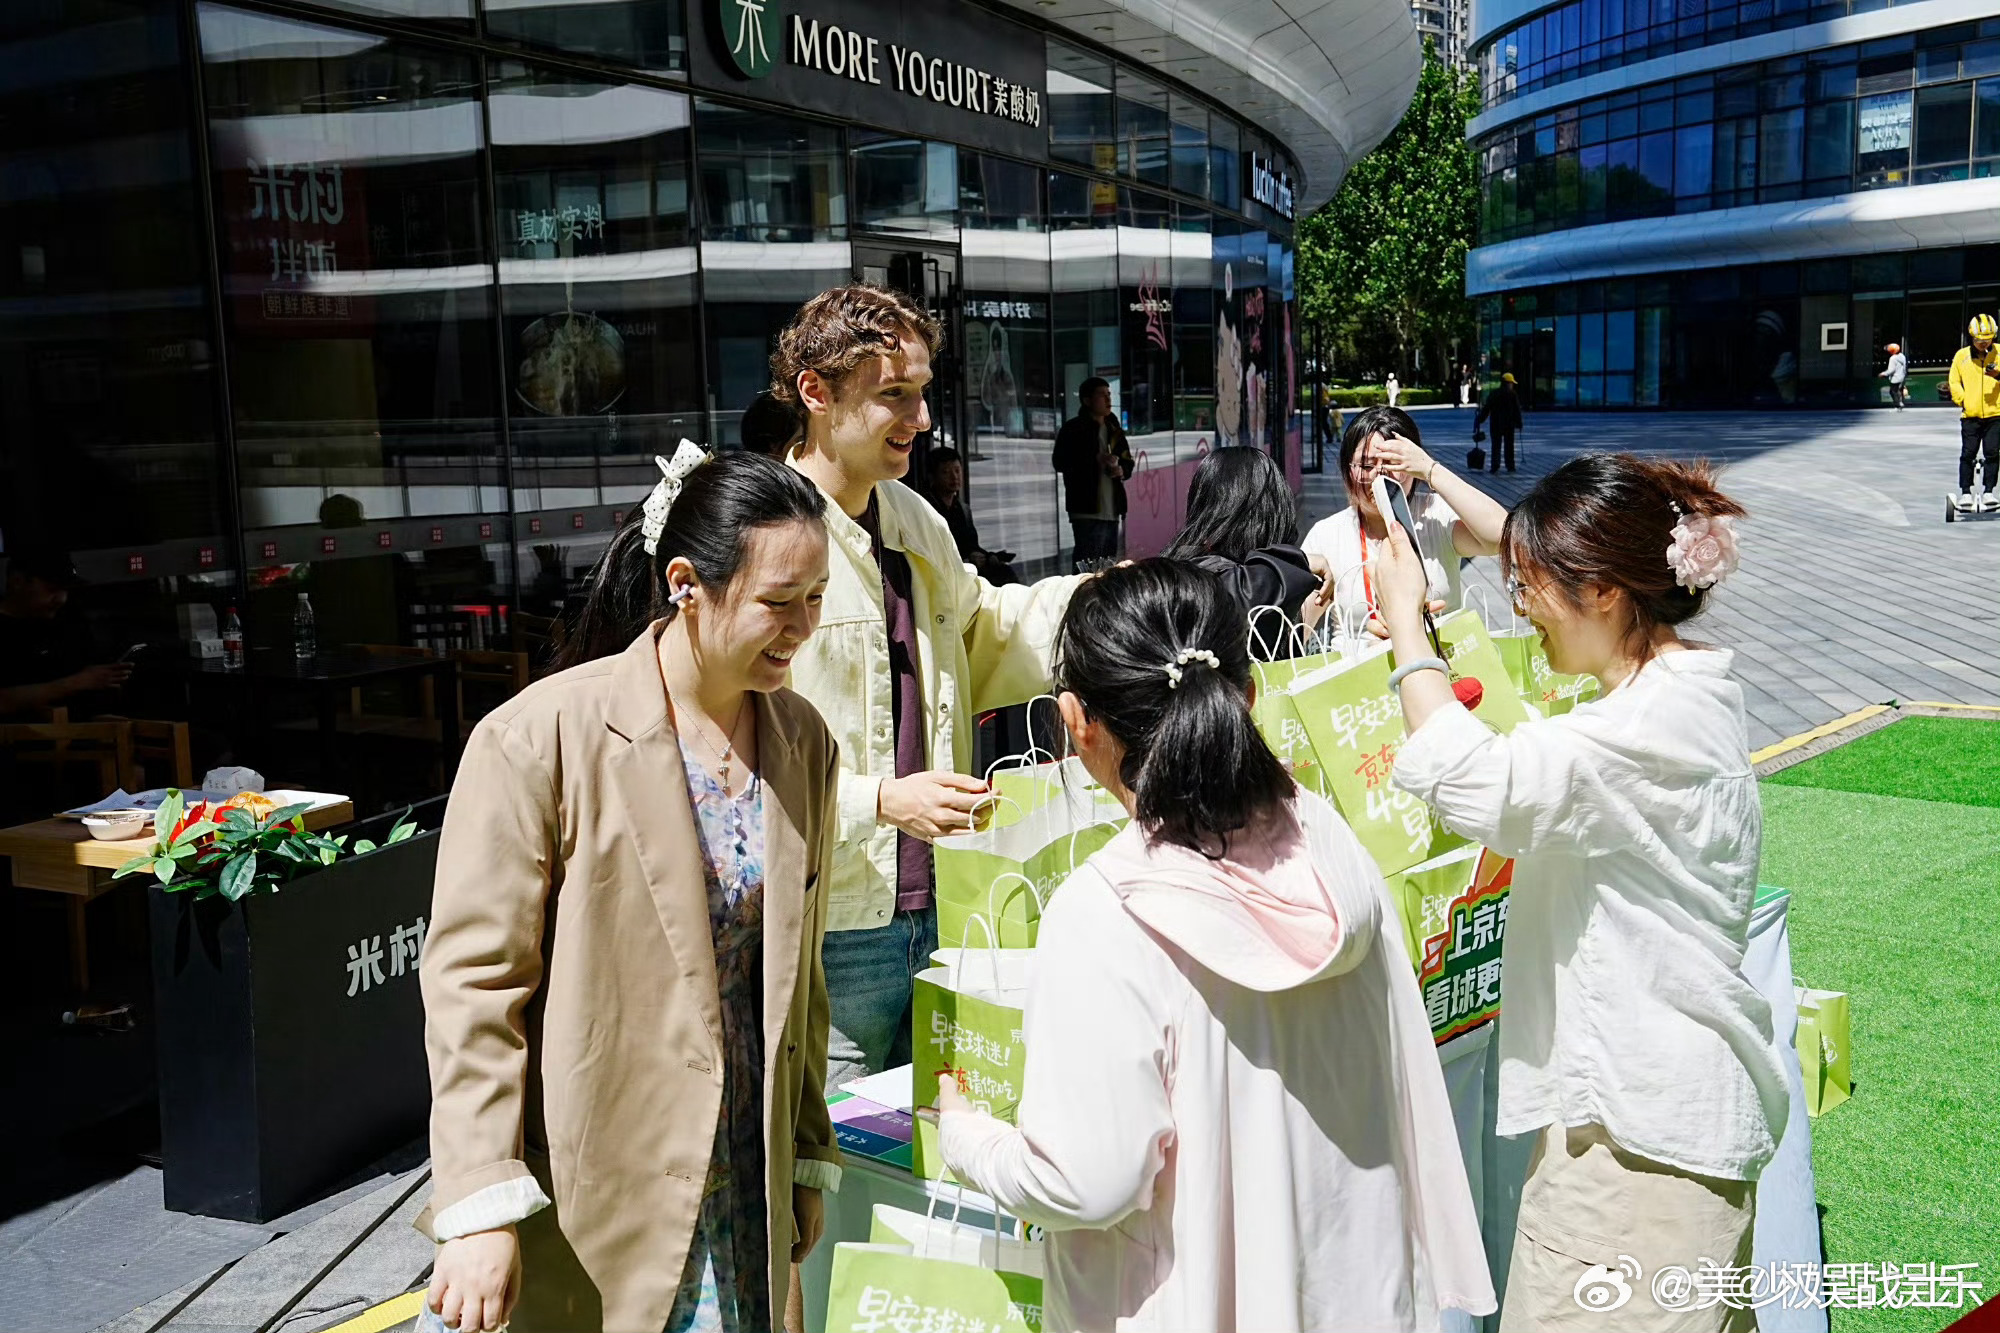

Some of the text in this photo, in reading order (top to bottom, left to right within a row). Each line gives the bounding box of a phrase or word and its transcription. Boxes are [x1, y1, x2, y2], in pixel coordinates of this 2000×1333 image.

[792, 14, 881, 86] MORE
[890, 44, 991, 114] YOGURT
[992, 77, 1041, 128] 茉酸奶
[517, 203, 606, 247] 真材实料
[346, 916, 427, 998] 米村
[1425, 957, 1503, 1028] 看球更
[930, 1009, 1011, 1067] 早安球迷!
